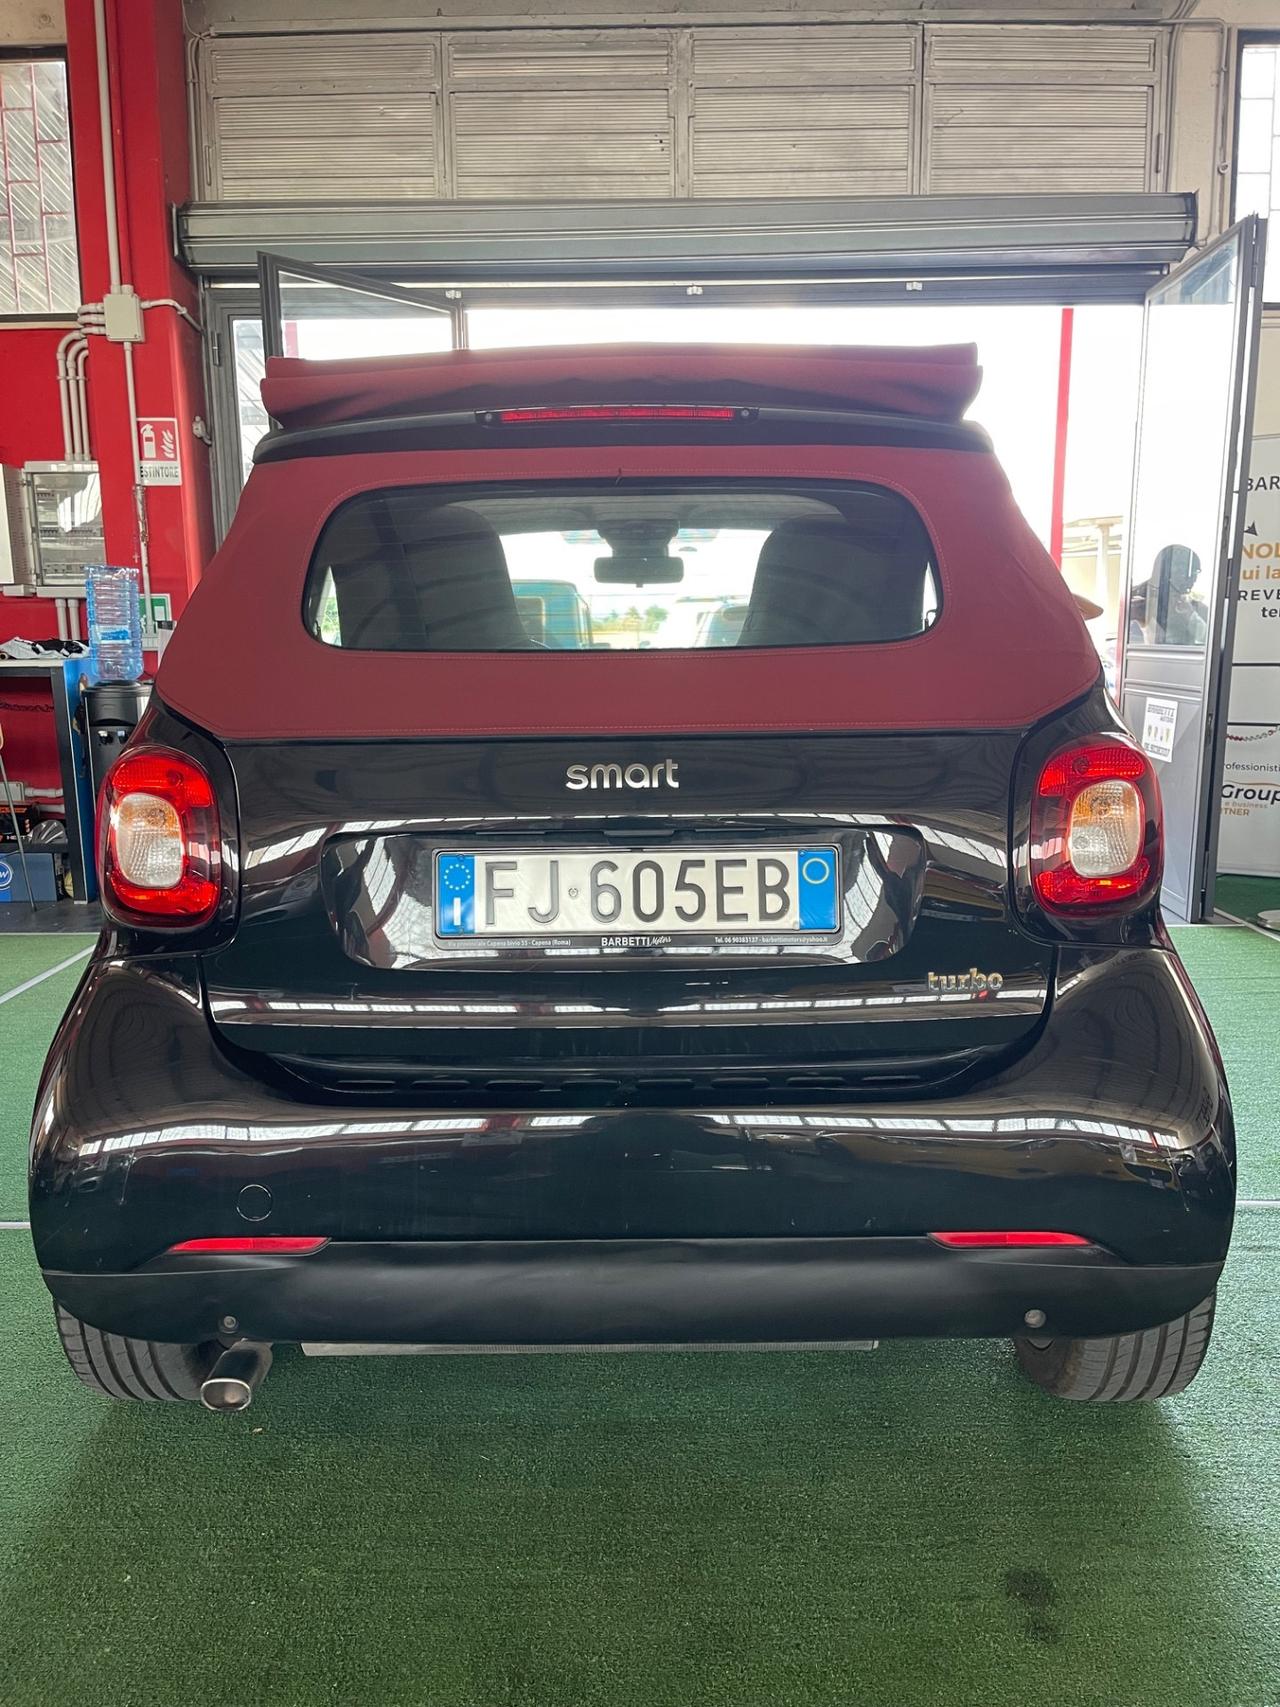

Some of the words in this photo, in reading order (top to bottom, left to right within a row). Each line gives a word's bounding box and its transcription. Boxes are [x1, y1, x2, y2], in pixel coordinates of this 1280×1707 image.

[140, 466, 178, 478] ESTINTORE
[1261, 606, 1280, 618] te
[1225, 762, 1280, 772] ofessionisti
[566, 759, 680, 789] smart
[601, 936, 650, 947] BARBETTI
[927, 967, 1003, 992] turbo
